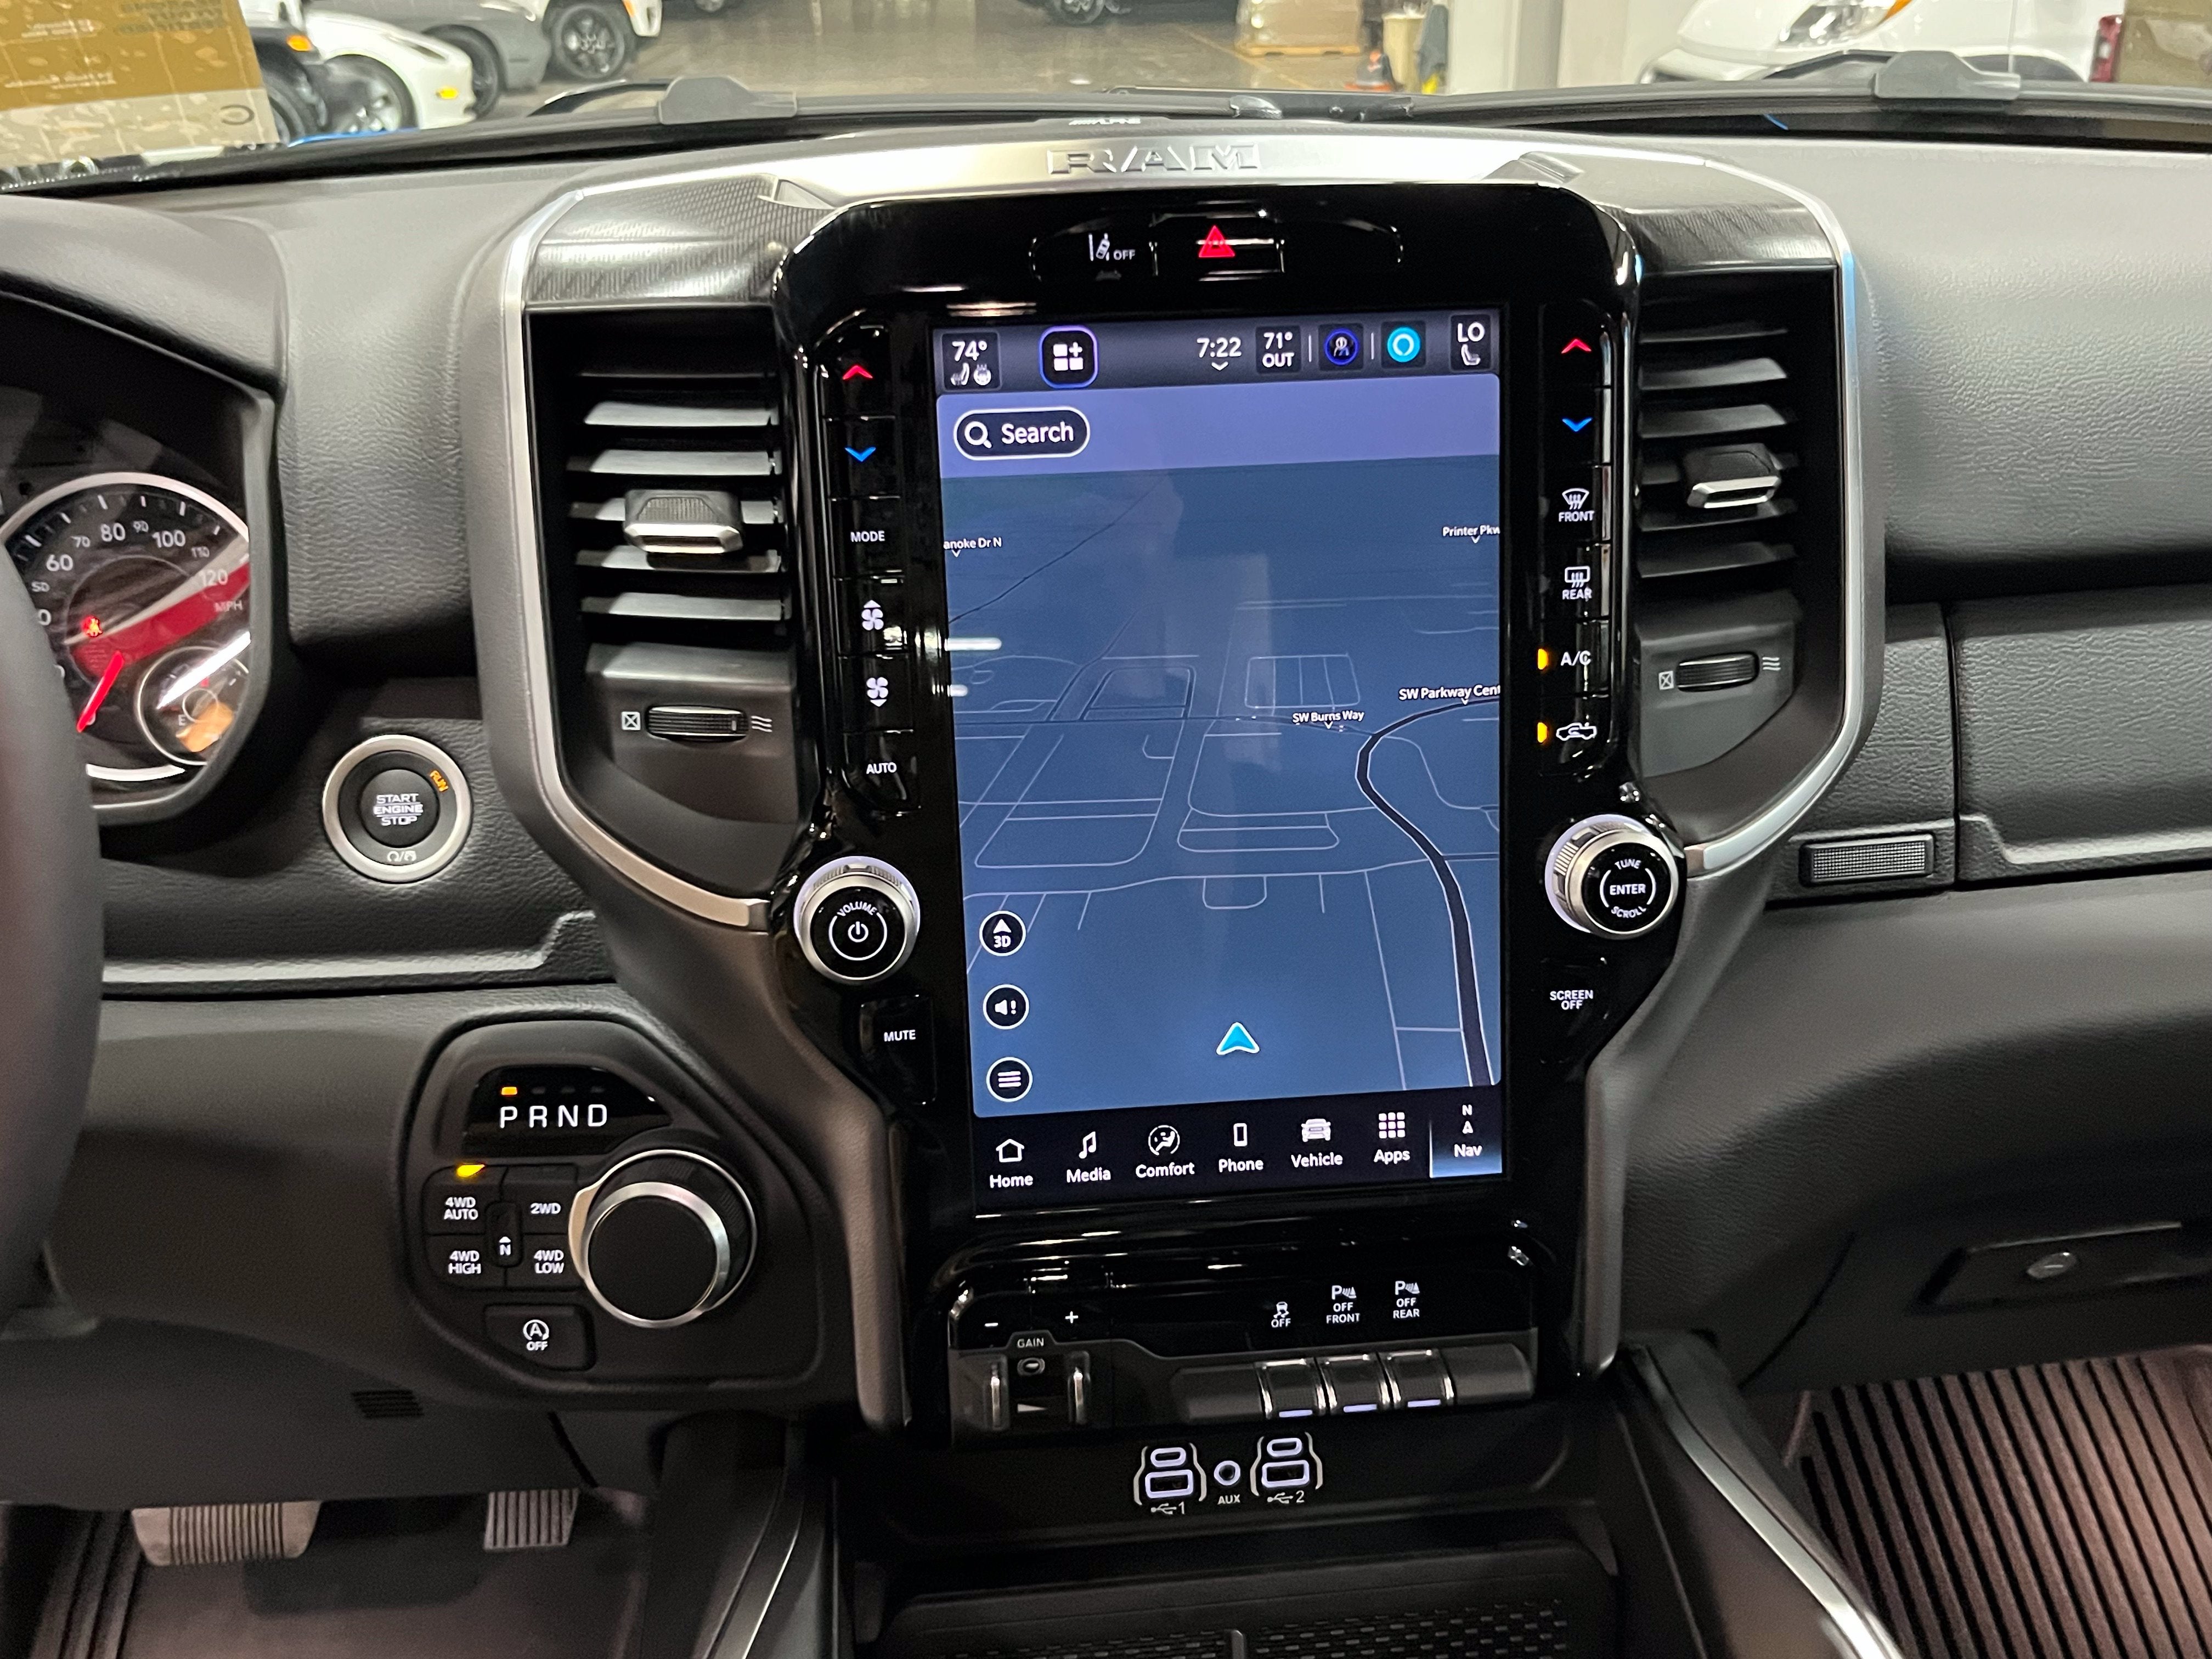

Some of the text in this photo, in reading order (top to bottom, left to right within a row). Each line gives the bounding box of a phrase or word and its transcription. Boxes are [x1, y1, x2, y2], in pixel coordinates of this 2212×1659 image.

[1046, 142, 1261, 176] RAM
[1113, 249, 1136, 261] OFF
[1457, 323, 1485, 342] LO
[1196, 337, 1242, 358] 7:22
[1262, 353, 1295, 368] OUT
[1001, 421, 1073, 444] Search
[1559, 510, 1594, 522] FRONT
[100, 522, 126, 541] 80
[133, 520, 149, 533] 90
[1442, 526, 1477, 537] Printer
[71, 535, 91, 548] 70
[153, 530, 186, 548] 100
[850, 531, 885, 542] MODE
[978, 538, 991, 548] Dr
[994, 537, 1002, 547] N
[191, 546, 210, 558] 110
[46, 554, 73, 572] 60
[200, 569, 228, 586] 120
[31, 582, 50, 592] 50
[1562, 589, 1592, 599] REAR
[215, 601, 242, 612] MPH
[38, 611, 51, 625] 0
[1561, 651, 1591, 666] A/C
[1399, 688, 1419, 700] SW
[1421, 687, 1471, 699] Parkway
[1293, 710, 1364, 723] SW Burns Way
[866, 762, 896, 774] AUTO
[430, 770, 449, 792] RUN
[376, 793, 419, 804] START
[373, 804, 424, 814] ENGINE
[381, 816, 417, 826] STOP
[1615, 859, 1640, 869] TUNE
[1610, 884, 1646, 895] ENTER
[837, 901, 877, 917] VOLUME
[1611, 906, 1647, 918] SCROLL
[994, 935, 1011, 947] 3D
[1550, 990, 1593, 1000] SCREEN
[1561, 1000, 1583, 1009] OFF
[884, 1030, 916, 1041] MUTE
[1462, 1104, 1472, 1115] N
[1374, 1148, 1410, 1164] Apps
[1454, 1144, 1482, 1157] Nav
[1218, 1157, 1263, 1172] Phone
[1291, 1152, 1342, 1168] Vehicle
[1067, 1166, 1111, 1183] Media
[1135, 1162, 1194, 1179] Comfort
[990, 1172, 1033, 1188] Home
[445, 1197, 476, 1208] 4WD
[531, 1203, 560, 1214] 2WD
[444, 1209, 478, 1220] AUTO
[500, 1244, 511, 1255] N
[534, 1250, 563, 1261] 4WD
[450, 1250, 479, 1262] 4WD
[449, 1262, 481, 1274] HIGH
[535, 1262, 564, 1273] LOW
[1333, 1303, 1353, 1312] OFF
[1396, 1298, 1416, 1307] OFF
[1327, 1313, 1360, 1324] FRONT
[1393, 1309, 1419, 1318] REAR
[1271, 1318, 1291, 1328] OFF
[527, 1341, 547, 1350] OFF
[1017, 1338, 1044, 1348] GAIN
[1218, 1494, 1240, 1504] AUX
